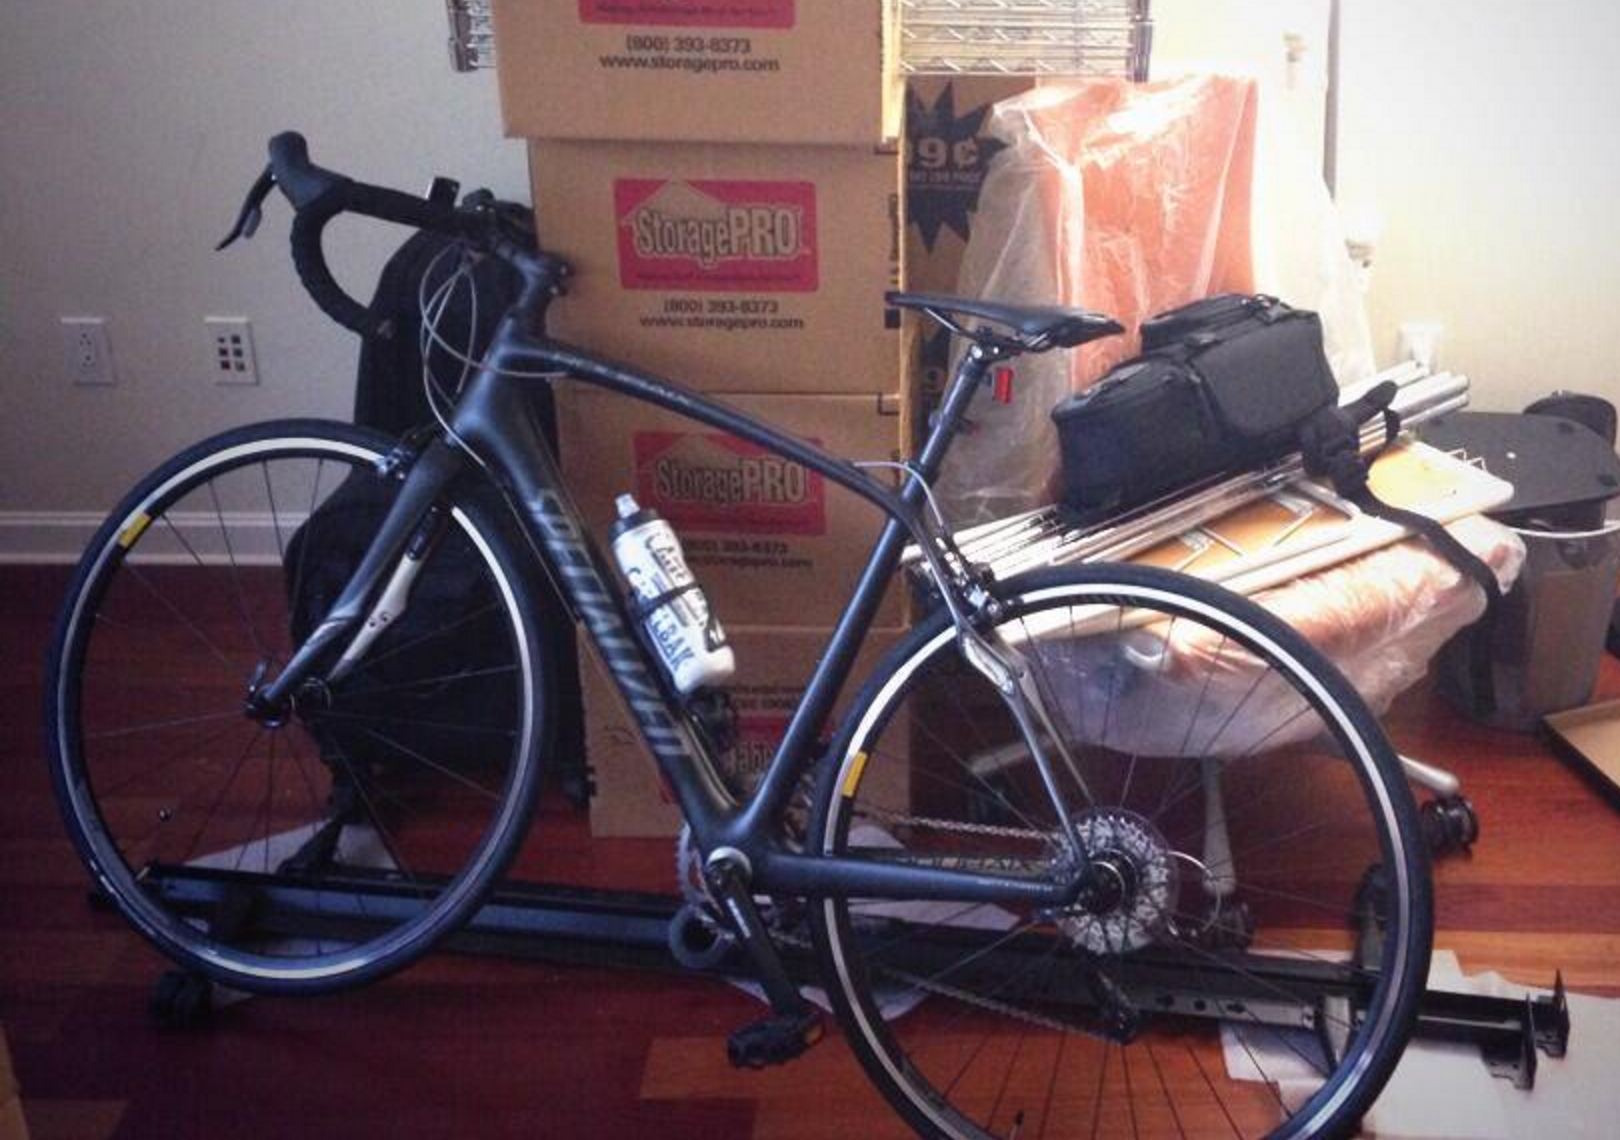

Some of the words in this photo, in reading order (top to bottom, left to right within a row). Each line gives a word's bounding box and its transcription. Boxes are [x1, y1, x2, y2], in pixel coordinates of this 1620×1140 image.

[599, 56, 780, 72] www.storagepro.com
[626, 35, 669, 53] (800)
[674, 37, 751, 53] 393-8373
[635, 207, 800, 264] StoragePRO
[655, 459, 806, 508] StoragePRO
[528, 487, 692, 757] SPECIALIZED
